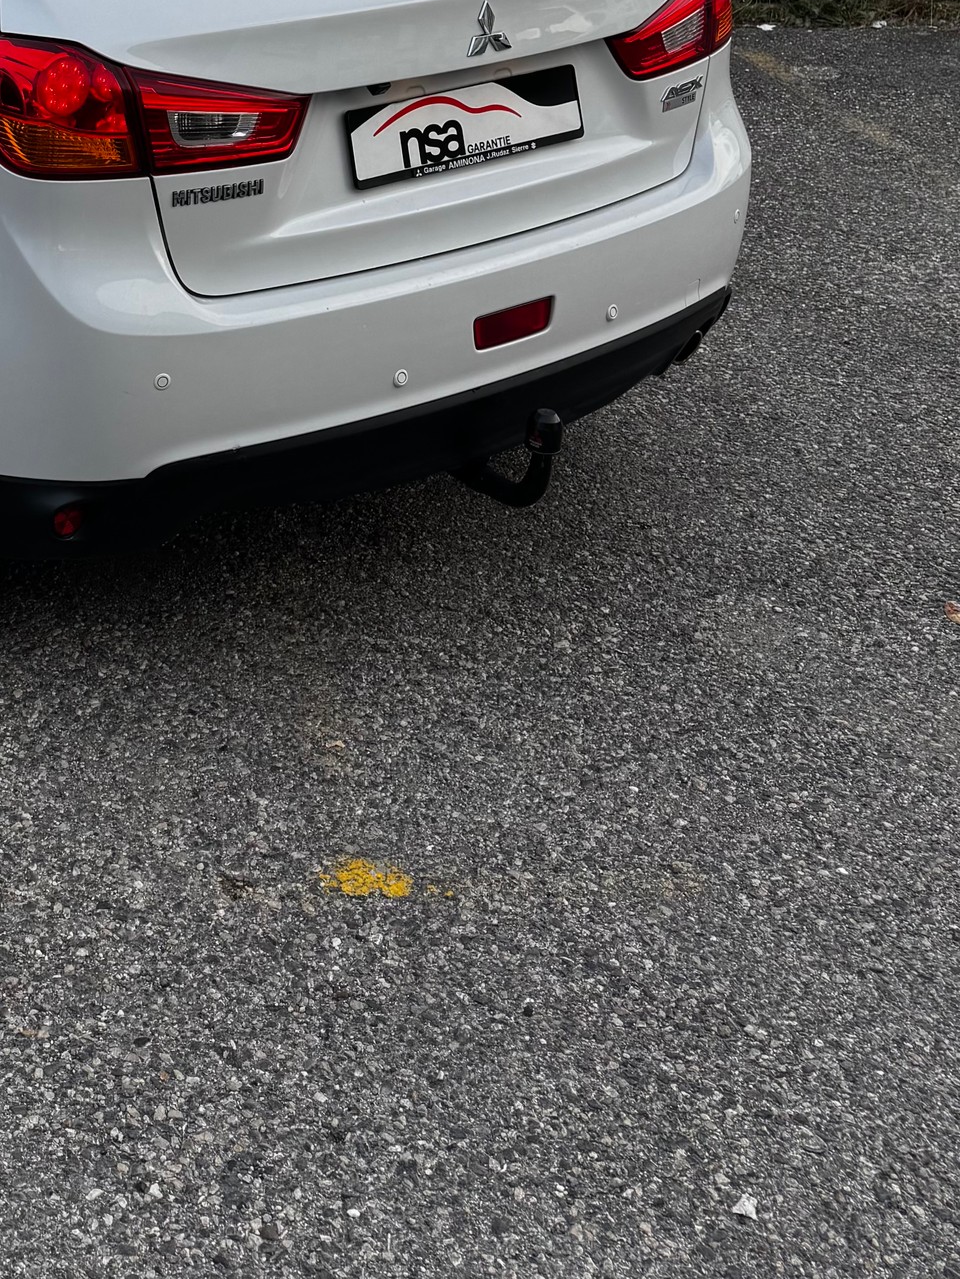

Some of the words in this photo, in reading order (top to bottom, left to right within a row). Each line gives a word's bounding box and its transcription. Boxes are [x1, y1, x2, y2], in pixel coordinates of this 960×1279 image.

[660, 74, 704, 102] ASX
[399, 119, 467, 168] nsa
[467, 135, 511, 154] GARANTIE
[423, 163, 446, 174] Garage
[448, 153, 486, 170] AMINONA
[511, 144, 529, 153] Sierre
[171, 179, 265, 207] MITSUBISHI
